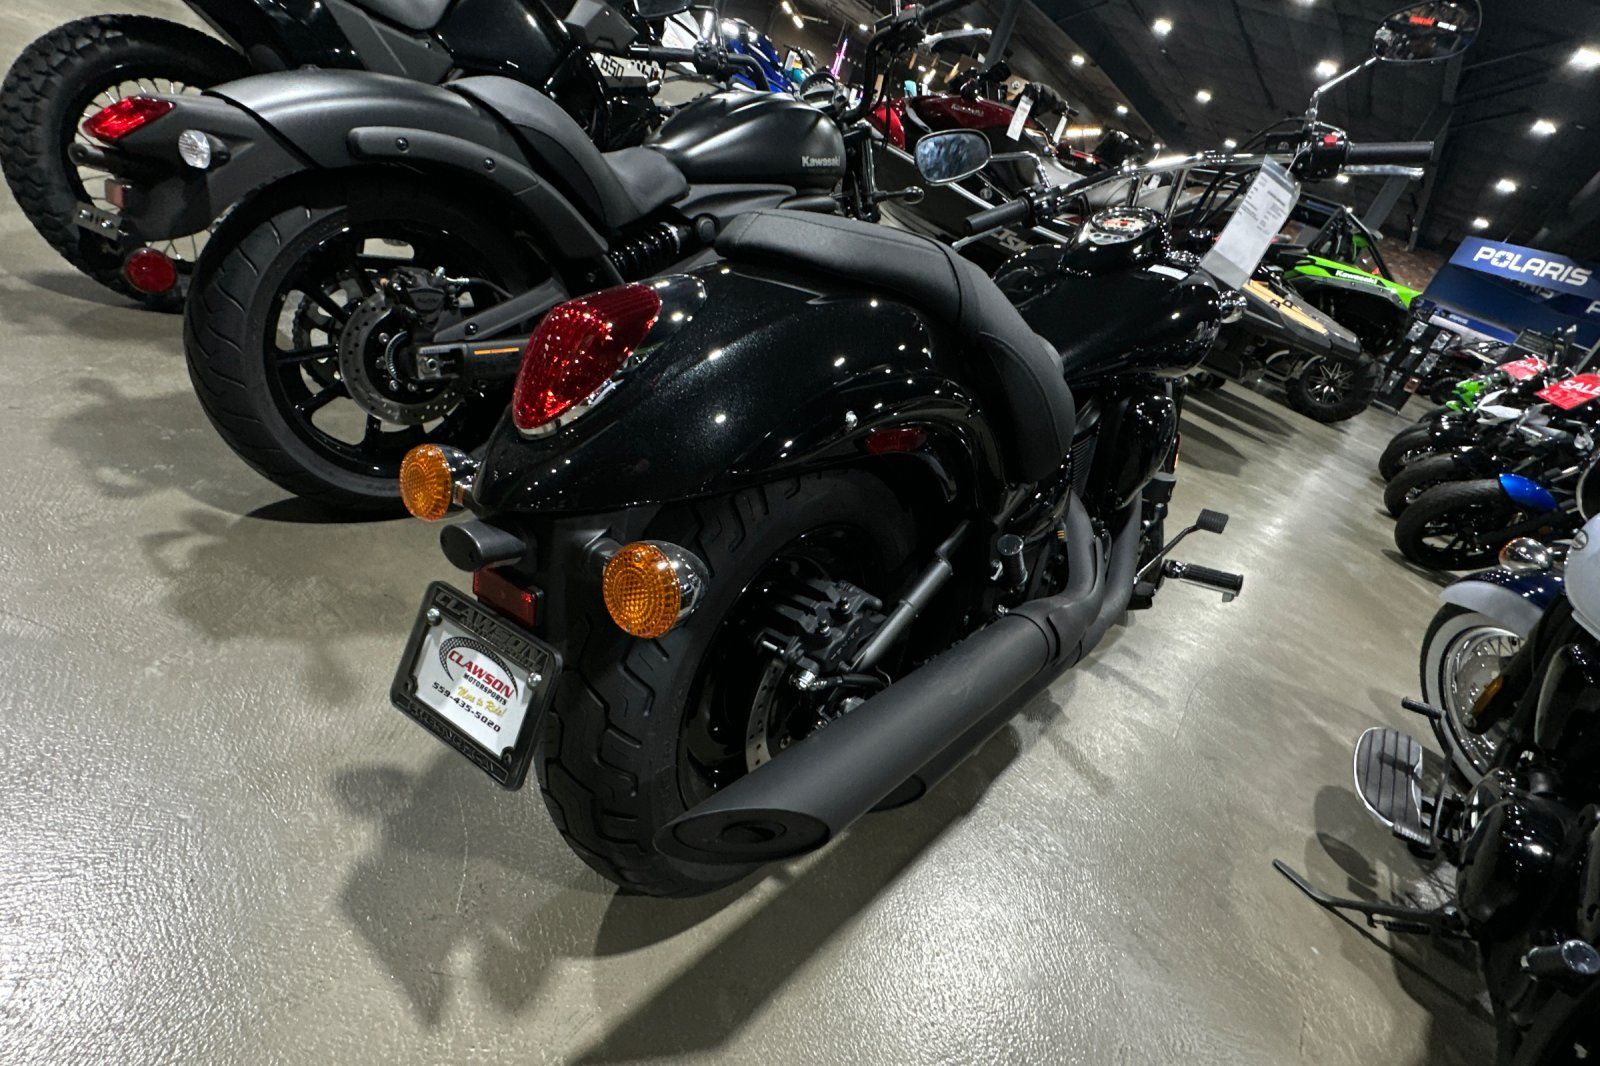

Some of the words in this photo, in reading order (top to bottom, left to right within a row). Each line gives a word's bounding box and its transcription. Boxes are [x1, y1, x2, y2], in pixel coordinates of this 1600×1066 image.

[801, 155, 841, 168] Kawasaki
[1335, 269, 1378, 285] Kawasaki
[1473, 246, 1593, 287] POLARIS
[435, 592, 545, 669] CLAWSON
[448, 650, 515, 699] CLAWSON
[463, 673, 508, 706] MOTORSPORTS
[432, 681, 501, 733] 559-435-5020
